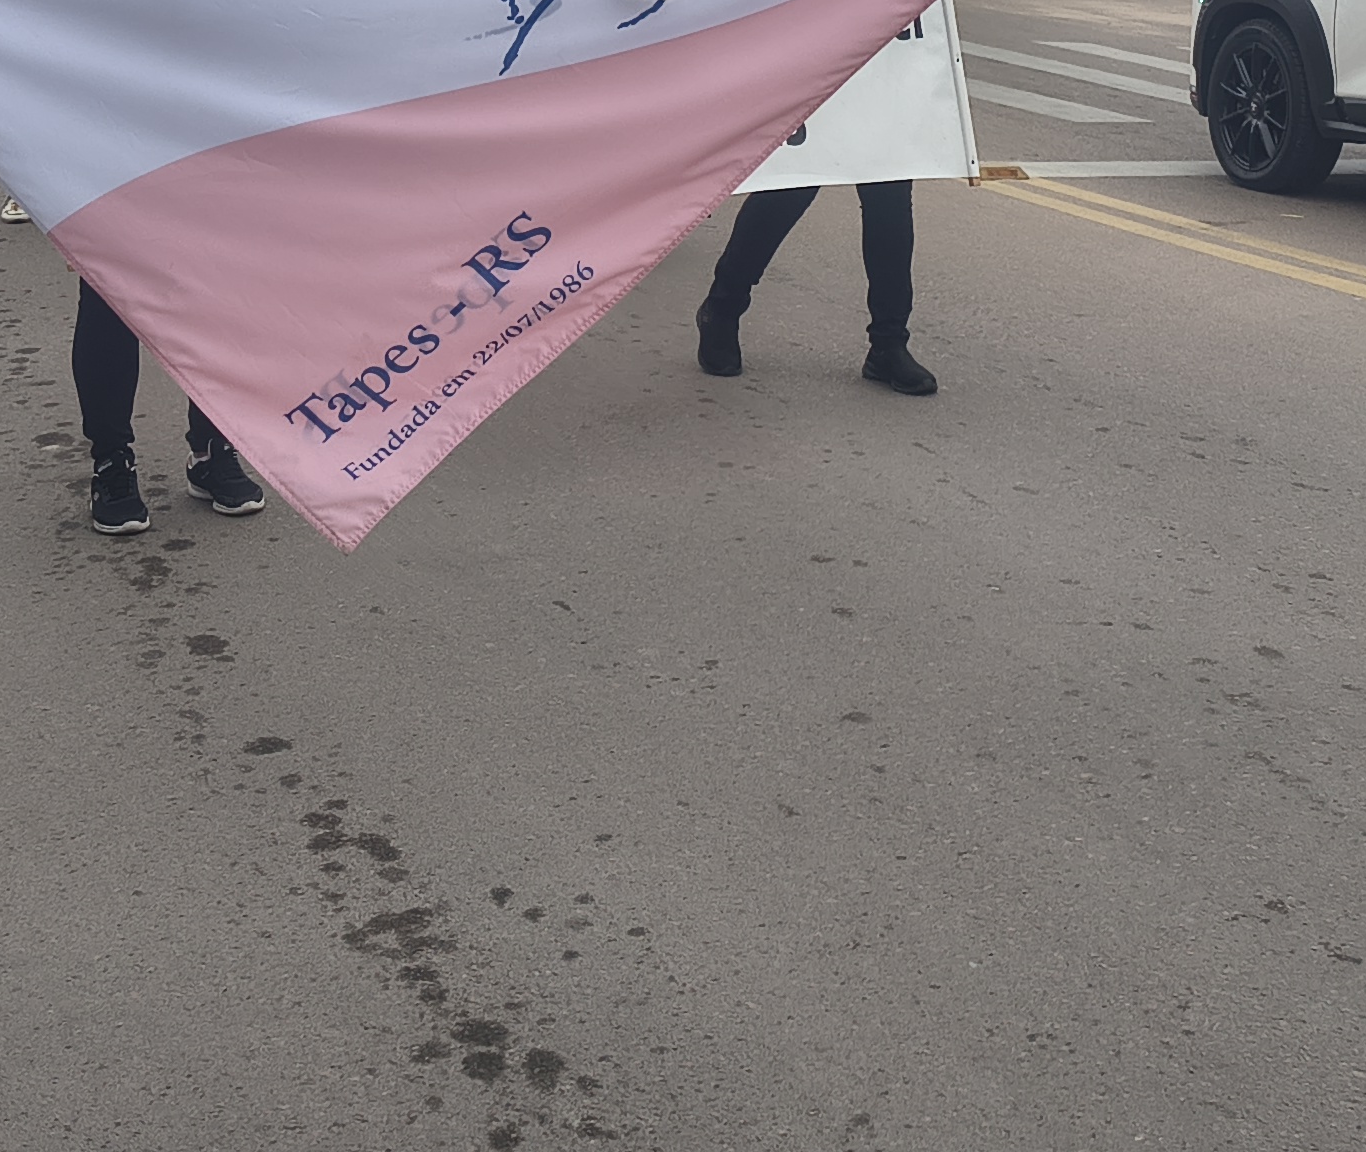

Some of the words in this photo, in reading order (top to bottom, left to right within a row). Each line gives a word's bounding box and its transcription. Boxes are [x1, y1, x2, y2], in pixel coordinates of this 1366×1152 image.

[283, 324, 441, 444] Tapes
[461, 210, 552, 298] RS
[340, 399, 442, 481] Fundada
[441, 366, 477, 398] em
[472, 260, 595, 366] 22/07/1986
